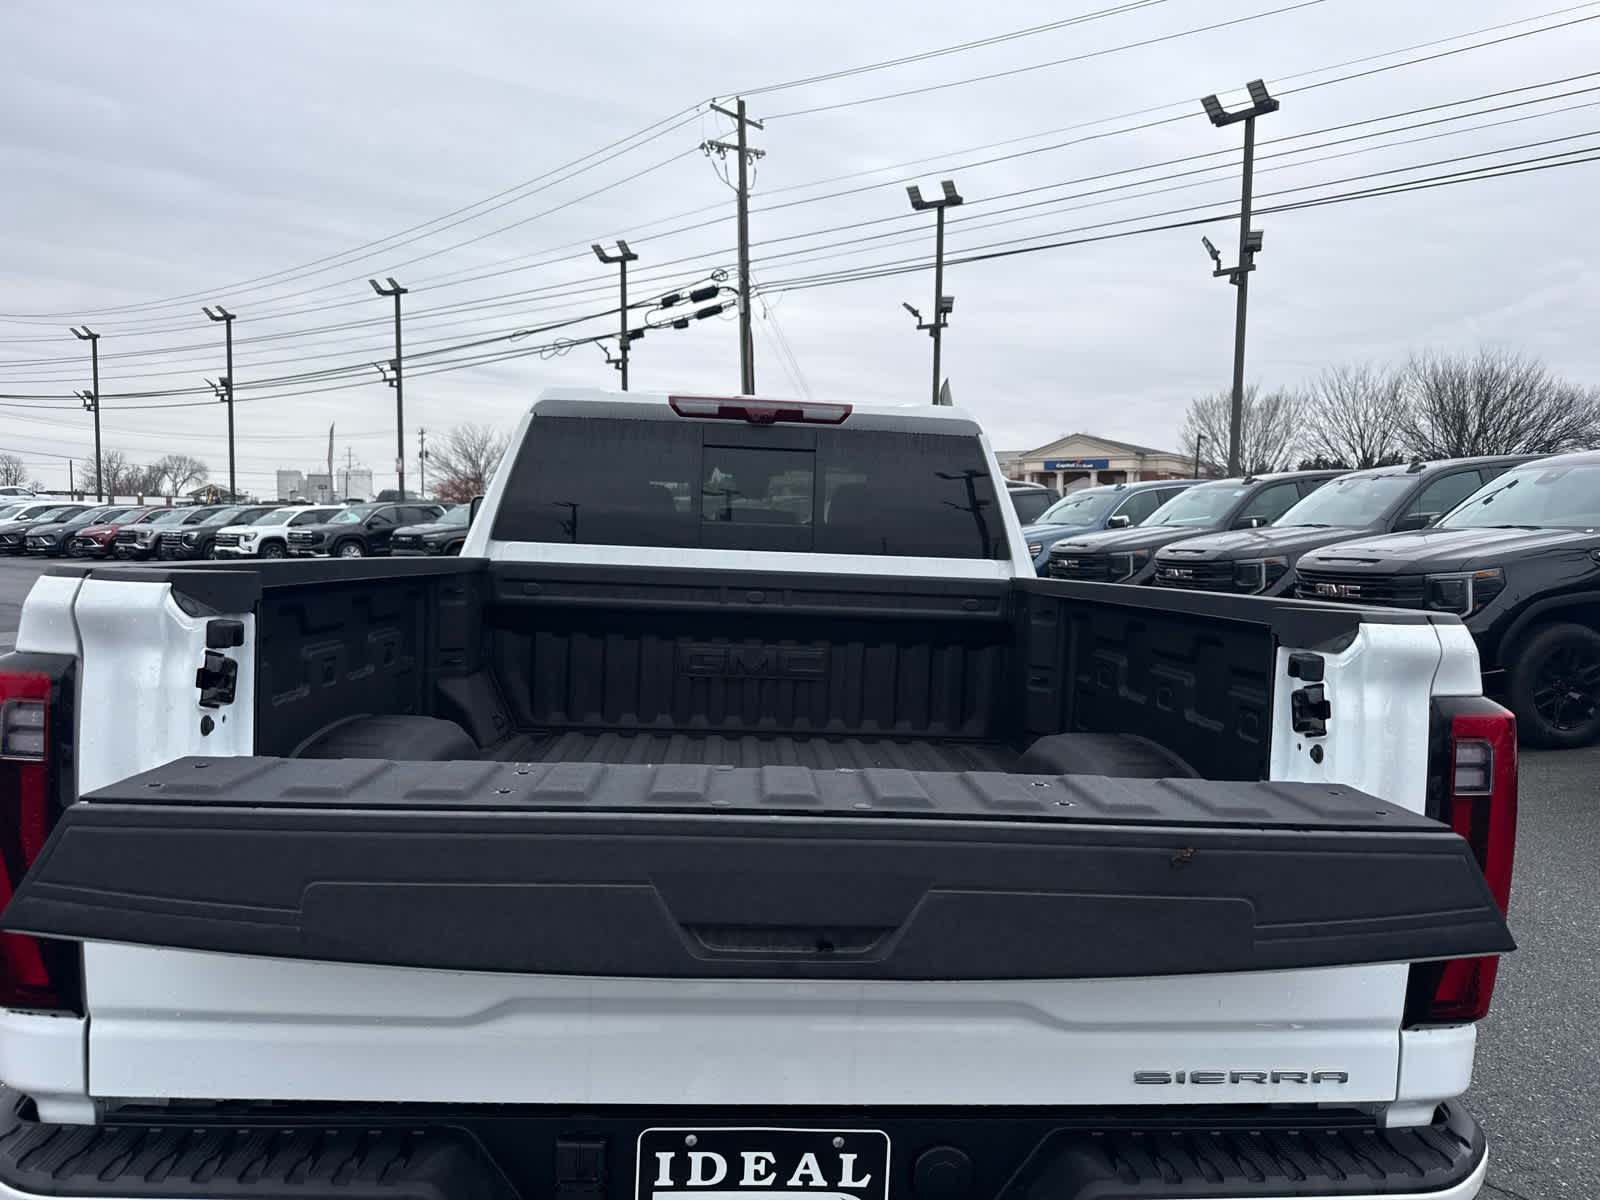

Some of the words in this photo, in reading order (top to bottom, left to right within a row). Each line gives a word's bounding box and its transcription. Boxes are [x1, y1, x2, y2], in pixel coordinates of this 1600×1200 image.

[1165, 568, 1193, 579] GMC
[1314, 583, 1361, 598] GMC
[679, 642, 825, 680] GMC
[1133, 1070, 1349, 1085] SIERRA
[653, 1151, 872, 1188] IDEAL
